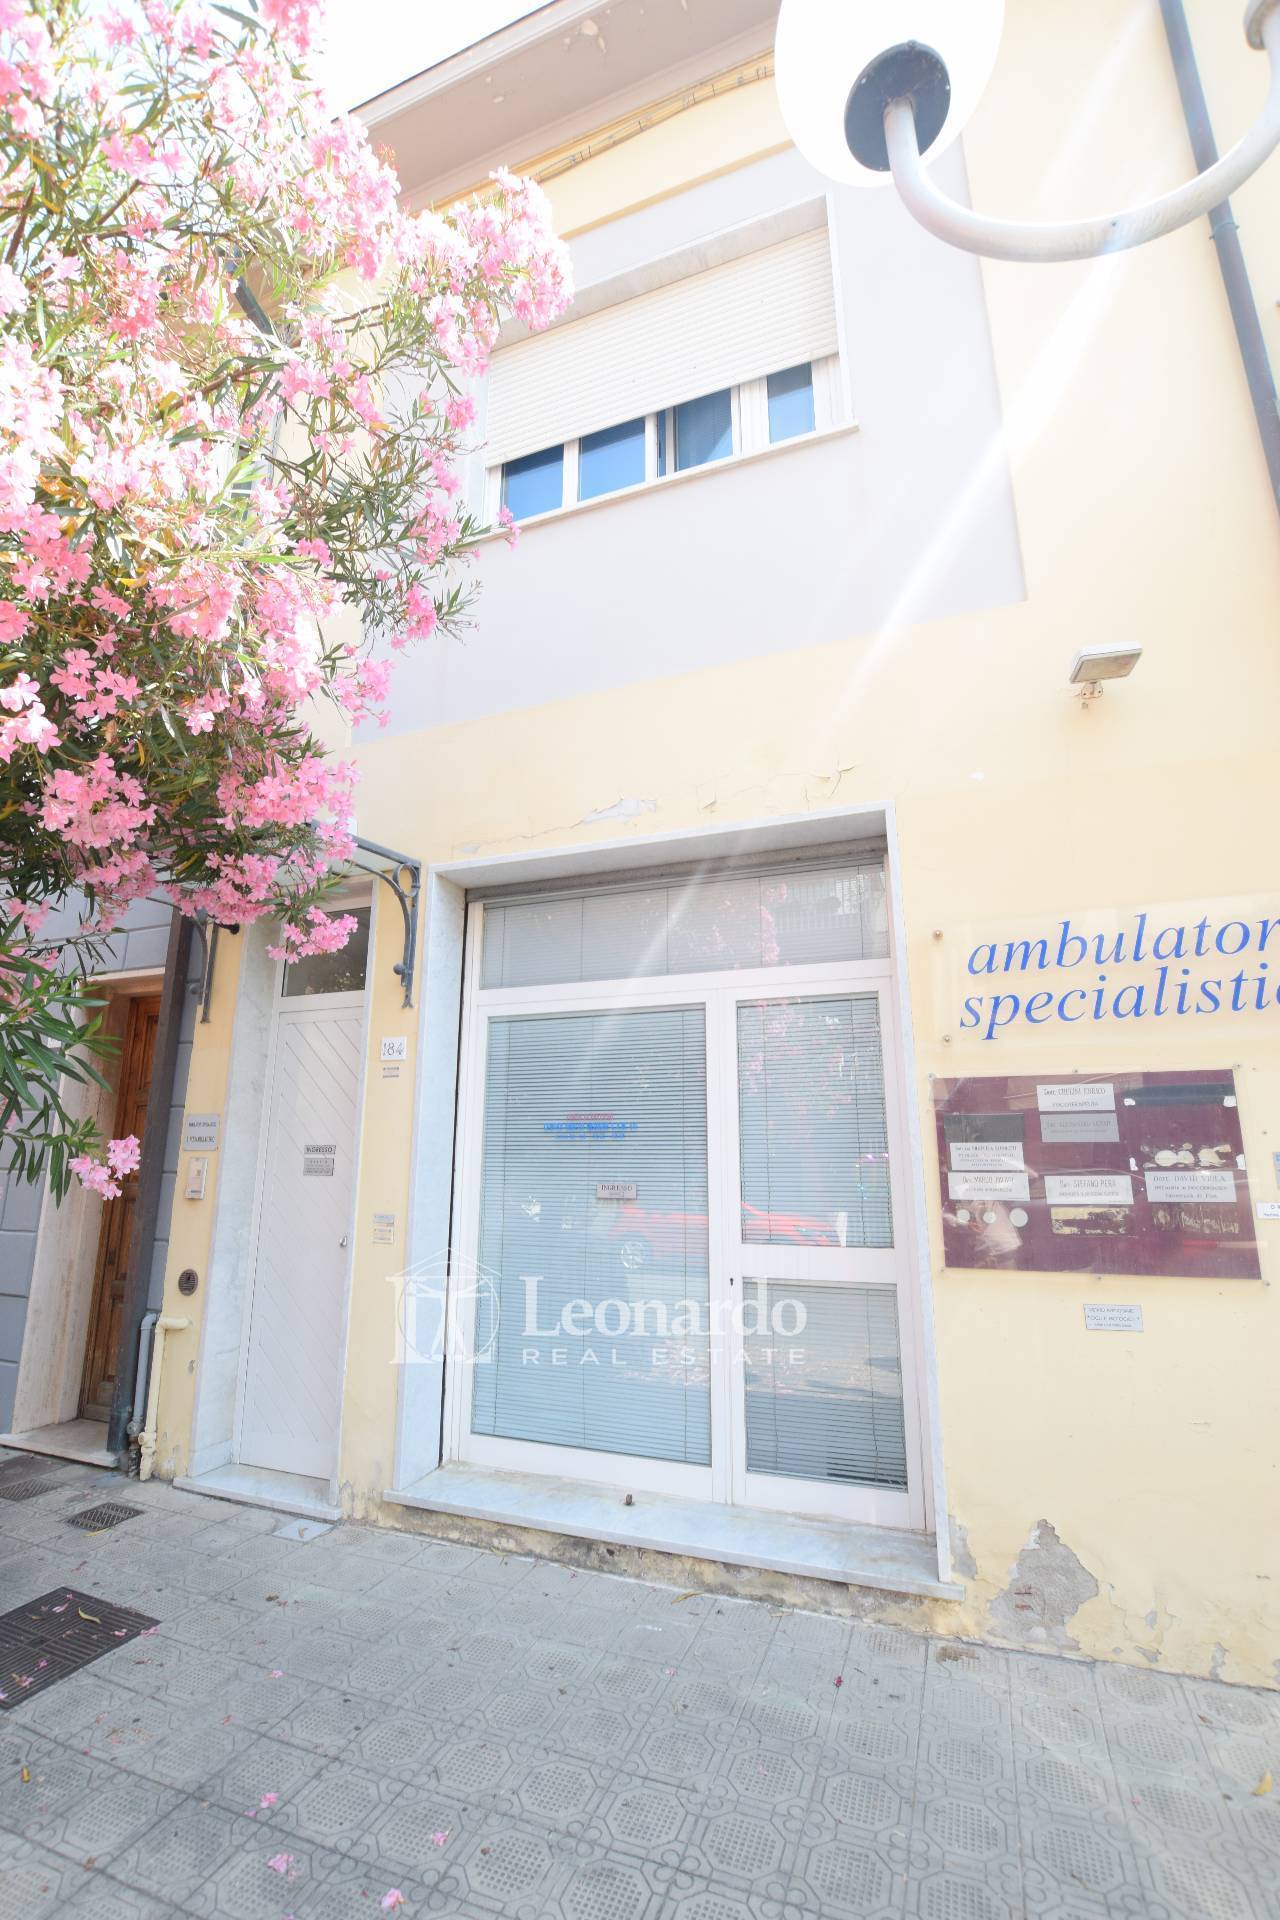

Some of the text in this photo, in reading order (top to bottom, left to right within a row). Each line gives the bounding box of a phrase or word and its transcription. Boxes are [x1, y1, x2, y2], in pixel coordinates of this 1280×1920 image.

[967, 912, 1280, 975] ambulator
[959, 962, 1280, 1041] specialisti
[383, 1042, 404, 1056] 184
[600, 1184, 633, 1192] INGRESSO
